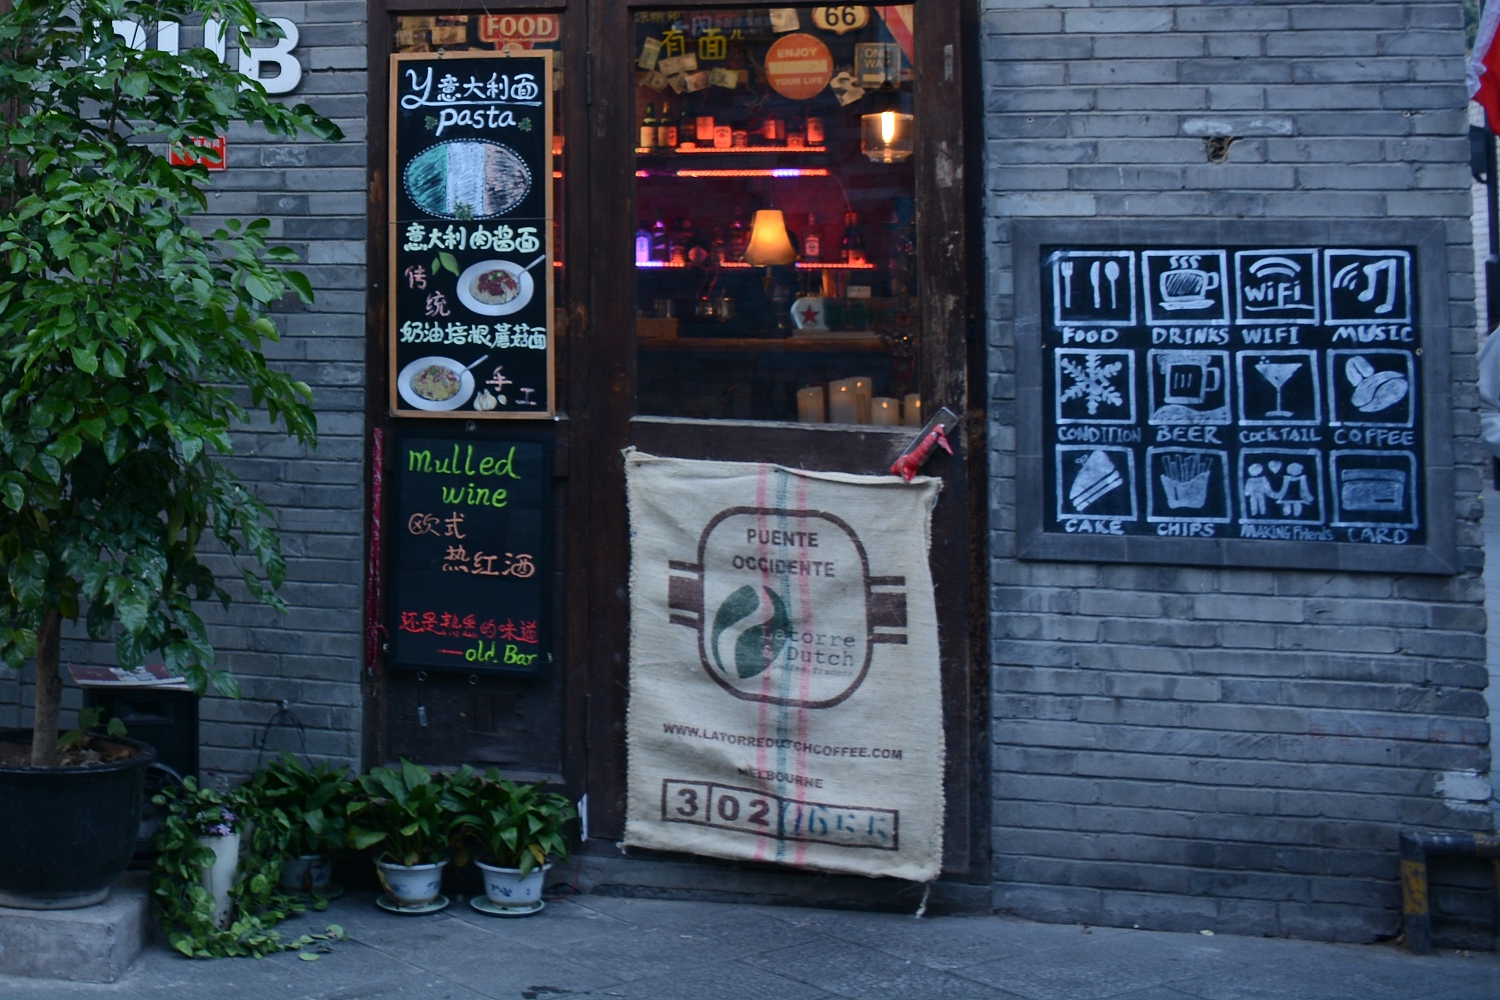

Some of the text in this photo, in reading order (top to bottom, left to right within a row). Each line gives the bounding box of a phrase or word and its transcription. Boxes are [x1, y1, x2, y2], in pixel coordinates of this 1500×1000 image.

[825, 6, 856, 27] 66
[486, 16, 553, 37] FOOD
[777, 47, 818, 58] ENJOY
[773, 75, 824, 88] YOUR LIFE
[1062, 326, 1119, 344] FOOD
[1152, 327, 1230, 345] DRINKS
[1241, 326, 1300, 345] WIFI
[1331, 324, 1414, 343] MUSIC
[1057, 425, 1141, 443] CONDITION
[1156, 425, 1222, 444] BEER
[1334, 428, 1415, 447] COFFEE
[442, 483, 508, 508] wine
[408, 511, 467, 540] 欧式
[1064, 519, 1124, 536] CAKE
[1156, 522, 1216, 538] CHIPS
[746, 527, 818, 548] PUENTE
[1347, 527, 1410, 545] CARD
[442, 544, 536, 579] 热红酒
[733, 555, 835, 578] OCCIDENTE
[786, 646, 854, 667] Dutch
[662, 722, 903, 761] WWW.LATORREDUTCHCOFFEE.COM
[737, 766, 824, 789] MELBOURNE
[675, 787, 699, 818] 3
